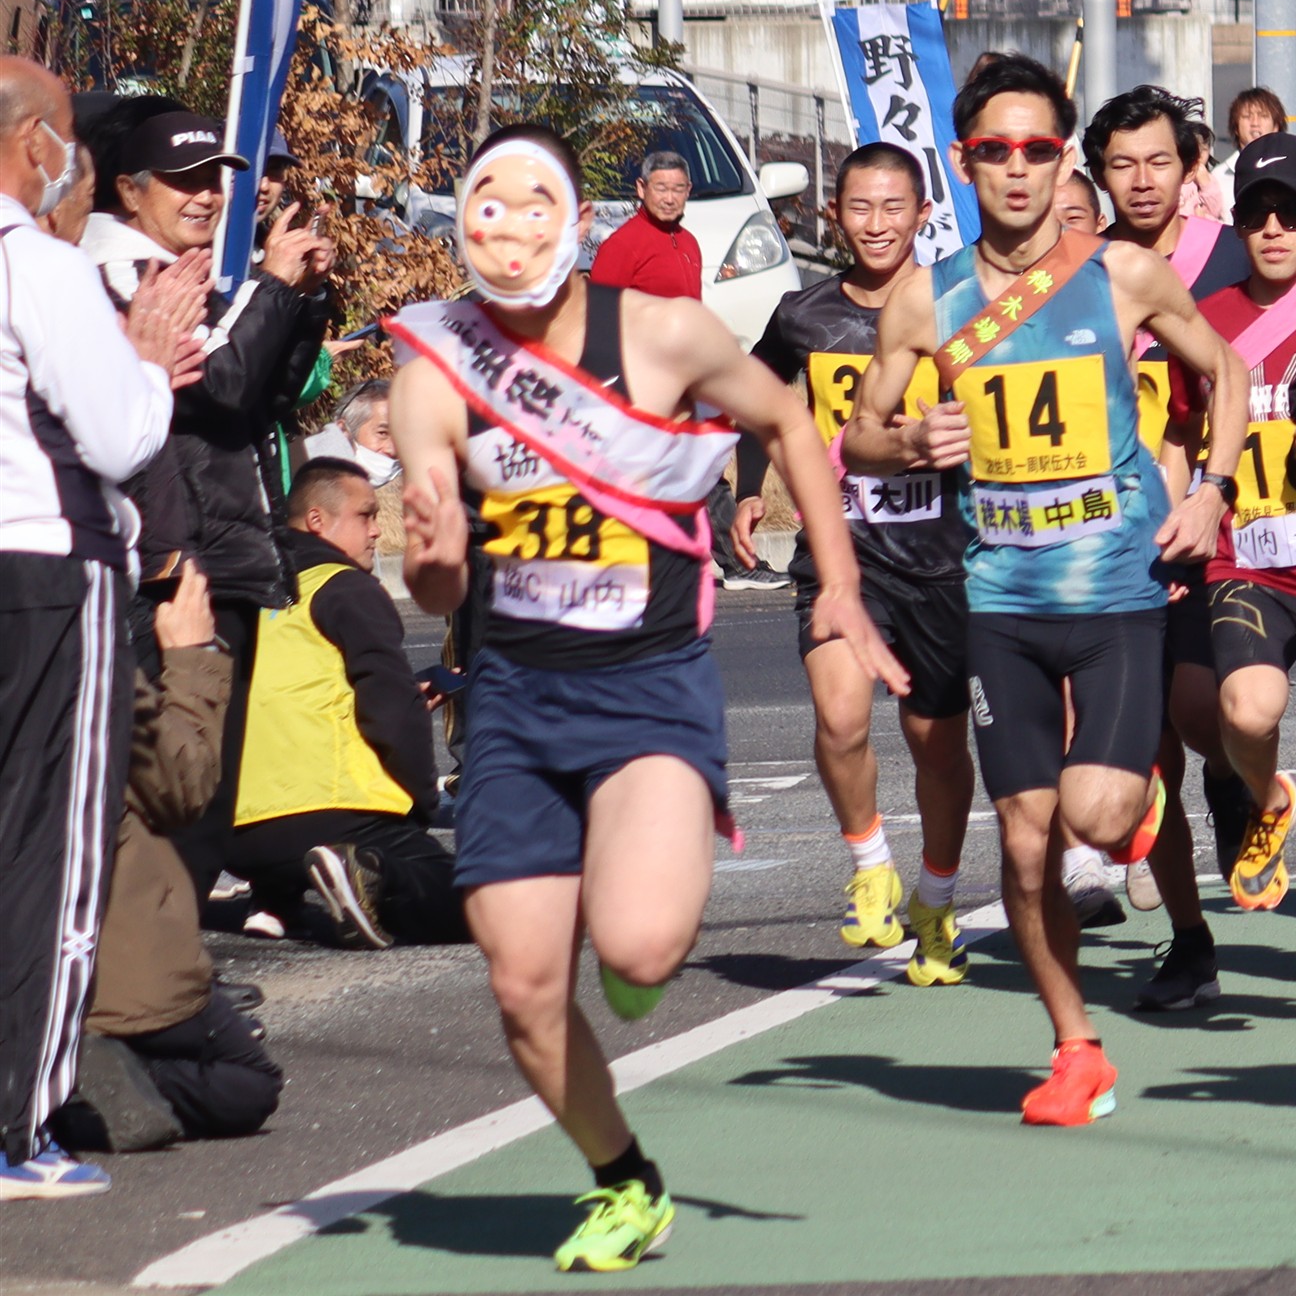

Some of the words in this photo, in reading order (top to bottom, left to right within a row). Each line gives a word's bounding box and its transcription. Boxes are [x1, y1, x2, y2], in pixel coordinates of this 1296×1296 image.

[984, 370, 1066, 450] 14
[871, 482, 933, 514] 大川
[1044, 487, 1113, 532] 中島
[510, 494, 606, 565] 38
[1237, 526, 1278, 562] 川内
